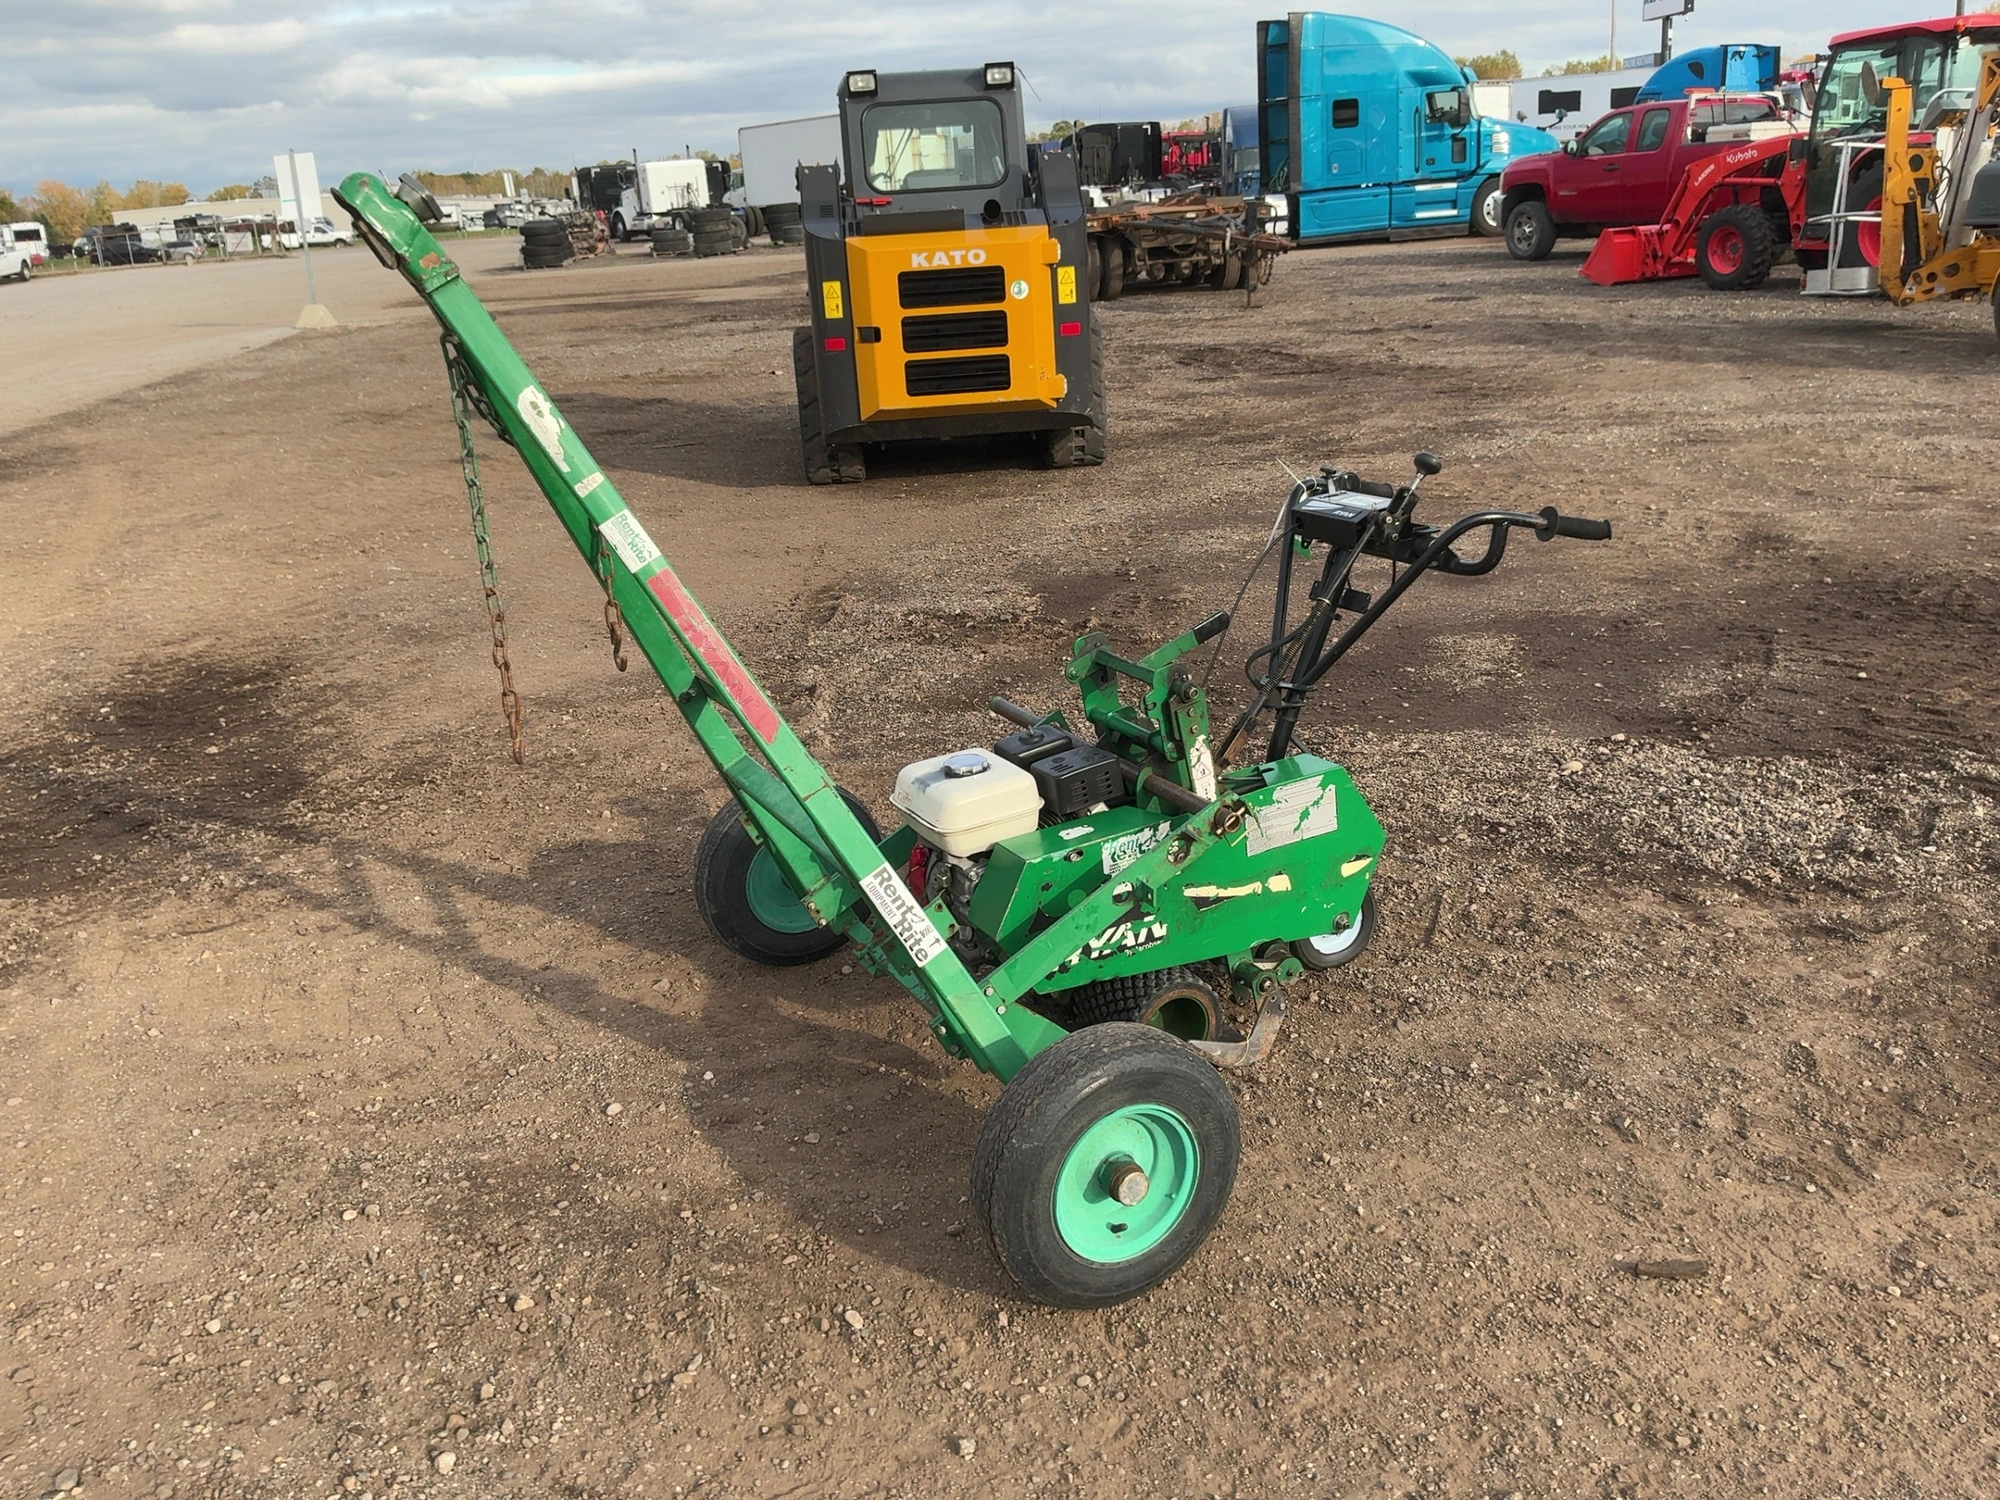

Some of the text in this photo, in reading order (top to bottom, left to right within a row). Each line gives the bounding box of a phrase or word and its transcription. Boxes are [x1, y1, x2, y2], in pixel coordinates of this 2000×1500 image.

[1726, 148, 1758, 164] Kubota
[911, 248, 987, 268] KATO
[618, 513, 641, 541] Rent
[627, 538, 647, 564] Rite
[866, 881, 897, 920] EQUIPMENT
[872, 866, 915, 920] Rent
[893, 918, 929, 962] Rite
